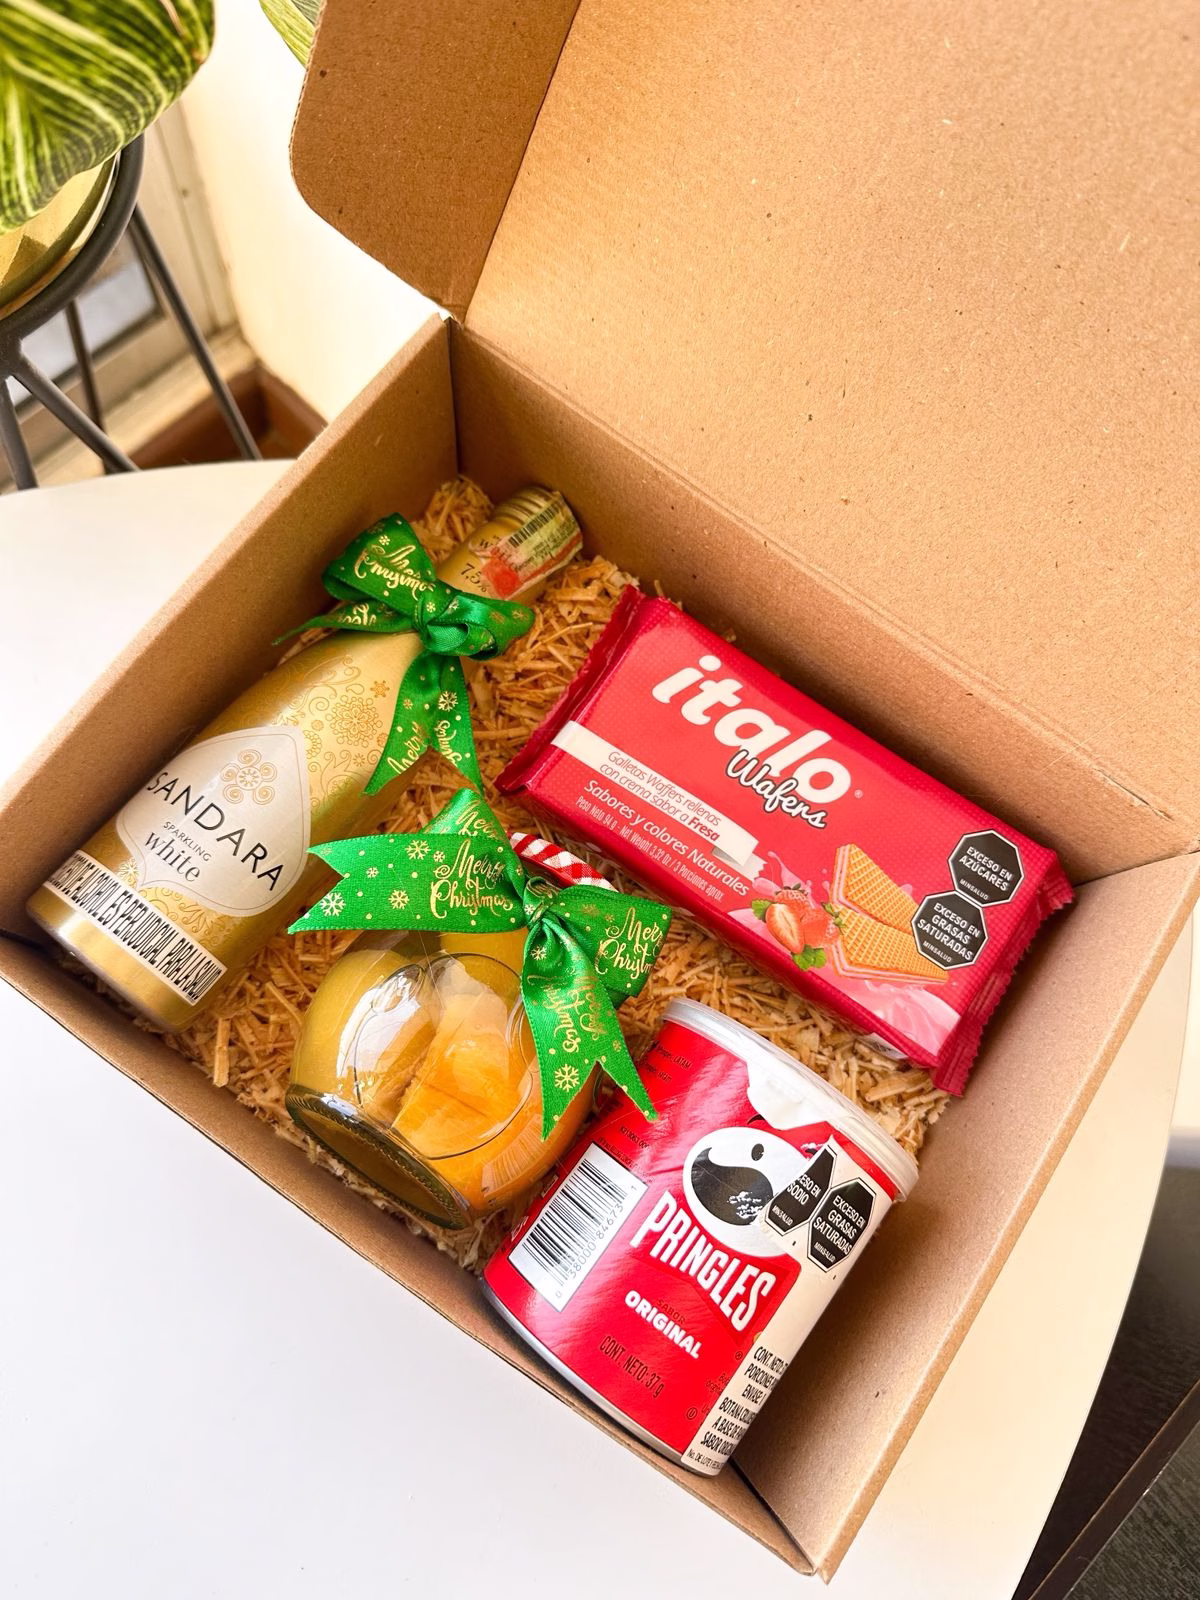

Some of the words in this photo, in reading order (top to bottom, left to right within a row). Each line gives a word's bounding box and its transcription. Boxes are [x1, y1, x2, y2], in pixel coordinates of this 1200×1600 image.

[651, 654, 851, 804] italo
[599, 763, 620, 779] con
[618, 774, 651, 800] crema
[649, 793, 681, 818] sabor
[679, 811, 690, 822] a
[687, 816, 721, 843] Fresa
[608, 751, 647, 782] Galletas
[646, 772, 684, 804] Waffers
[682, 793, 721, 826] rellenas
[725, 748, 828, 829] Wafers
[146, 771, 287, 892] SANDARA
[163, 820, 212, 862] SPARKLING
[575, 796, 592, 813] Peso
[589, 804, 606, 821] Neto
[620, 825, 634, 840] Net
[629, 831, 653, 853] Weight
[677, 864, 708, 892] Porciones
[584, 779, 636, 820] Sabores
[629, 812, 646, 827] y
[642, 819, 689, 855] colores
[686, 848, 750, 898] Naturales
[144, 831, 201, 883] white
[959, 854, 1010, 893] AZÚCARES
[966, 846, 1000, 873] EXCESO
[999, 868, 1014, 882] EN
[69, 868, 121, 918] ALCOHOL
[97, 889, 132, 927] ES
[107, 898, 181, 967] PERJUDICIAL
[916, 918, 974, 961] SATURADAS
[931, 914, 971, 945] GRASAS
[933, 902, 968, 929] EXCESO
[967, 924, 981, 938] EN
[155, 936, 201, 980] PARA
[173, 951, 207, 989] LA
[786, 1181, 810, 1206] SODIO
[811, 1185, 822, 1198] EN
[827, 1209, 858, 1240] GRASAS
[832, 1195, 858, 1220] EXCESO
[855, 1214, 866, 1229] EN
[813, 1216, 853, 1255] SATURADAS
[629, 1189, 777, 1332] PRINGLES
[624, 1289, 703, 1360] ORIGINAL
[656, 1298, 686, 1325] SABOR
[622, 1355, 650, 1384] NETO:
[711, 1415, 722, 1430] A
[717, 1417, 735, 1437] BASE
[718, 1396, 744, 1420] BOTANA
[700, 1430, 722, 1454] SABOR
